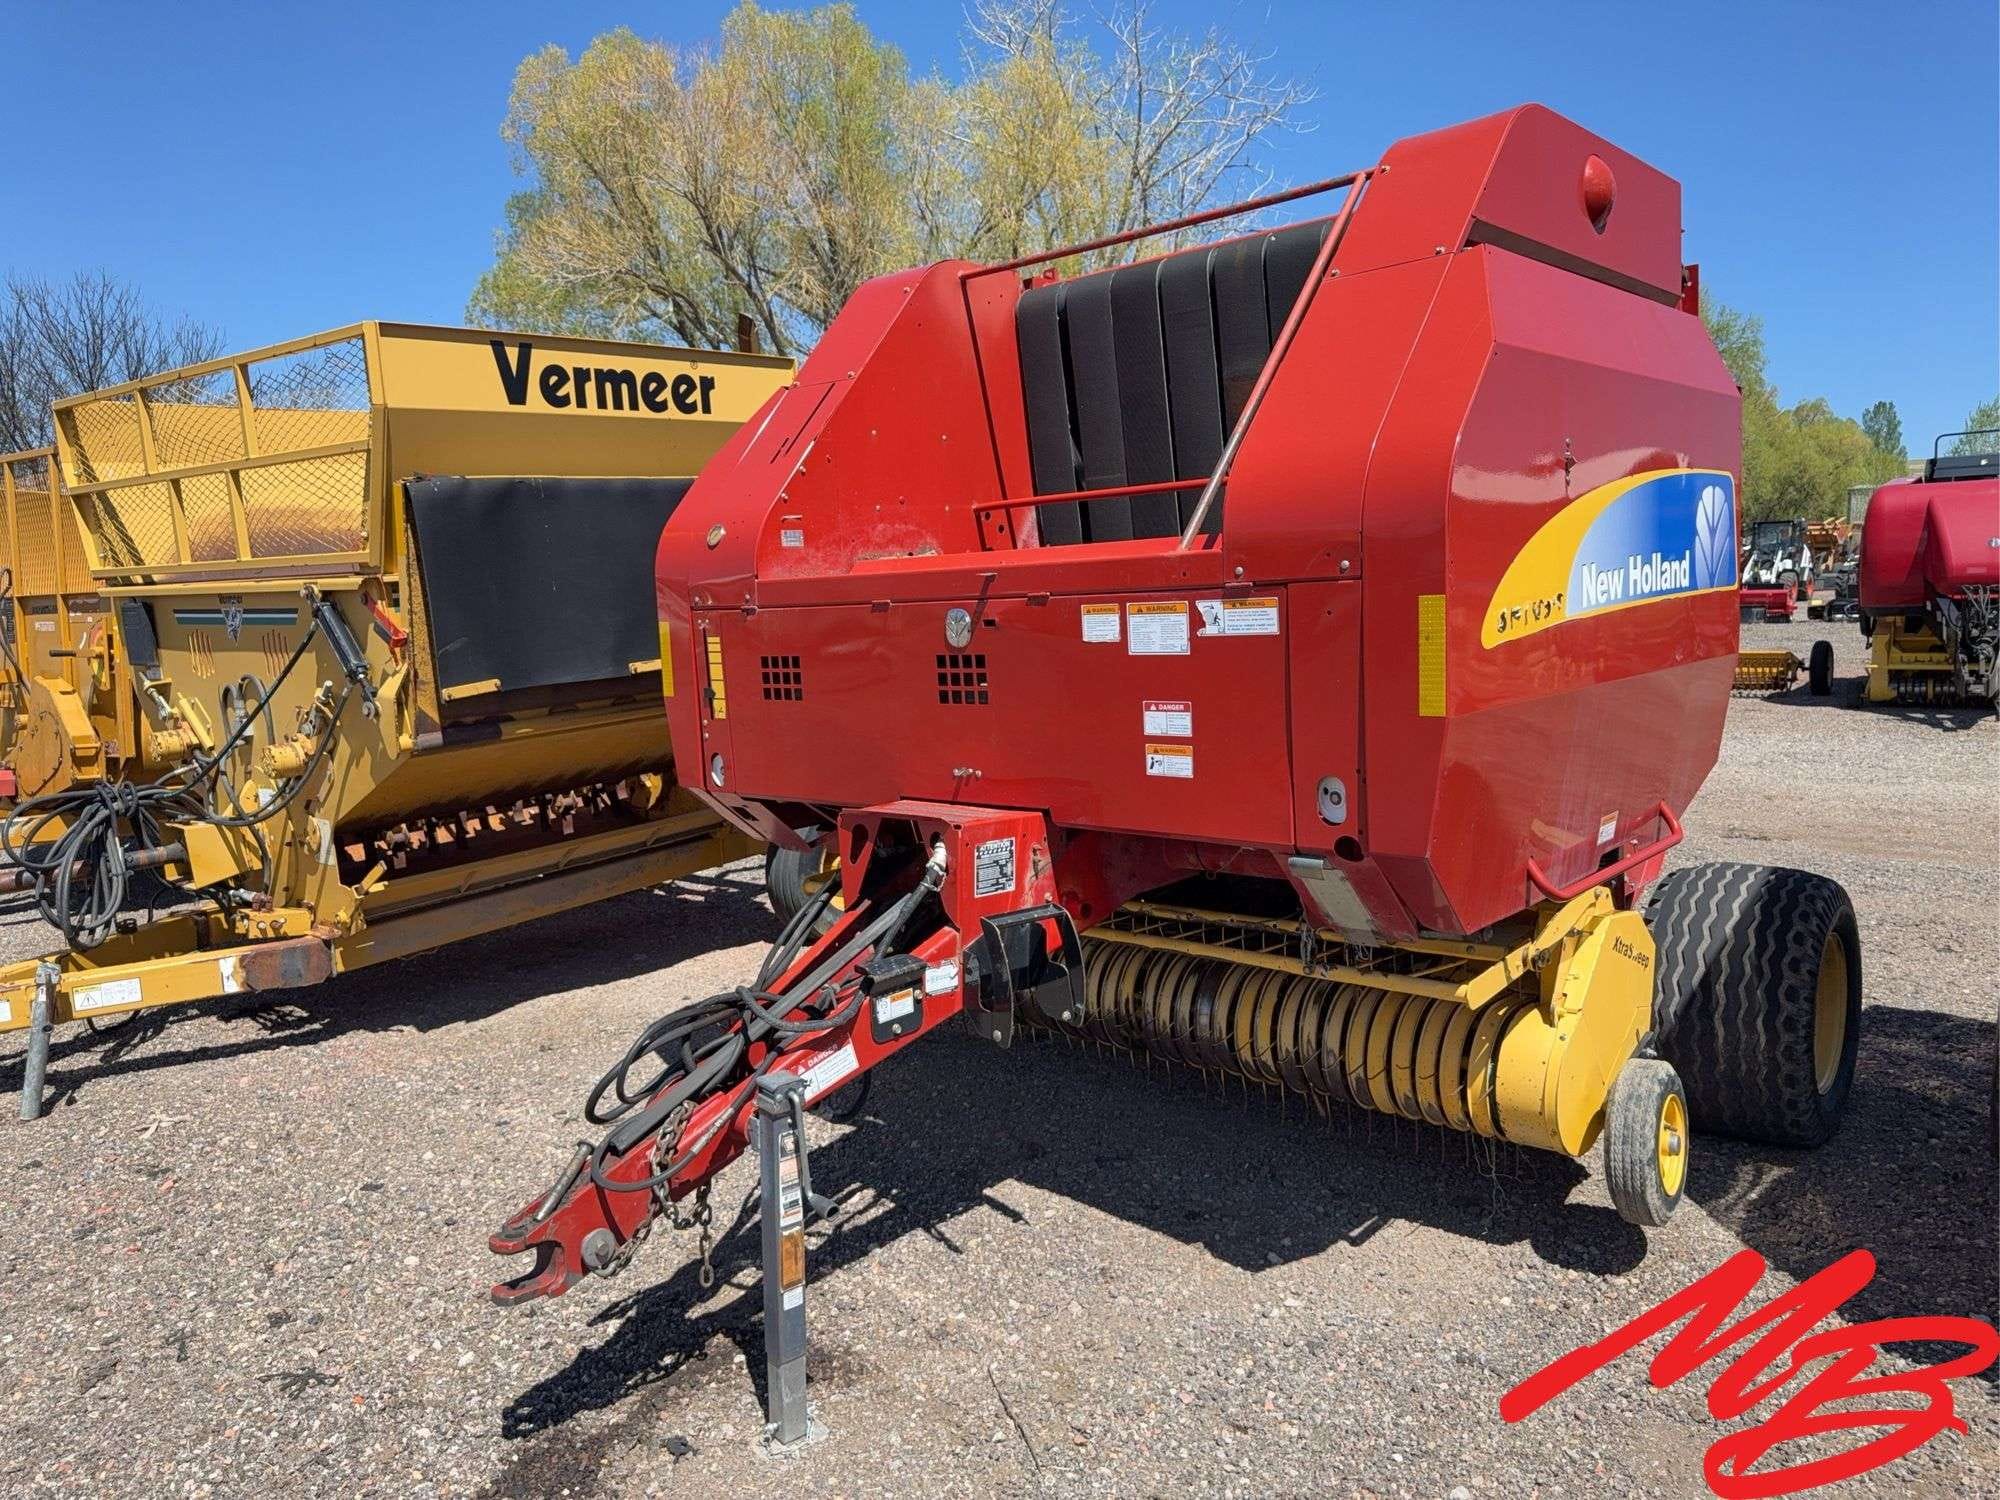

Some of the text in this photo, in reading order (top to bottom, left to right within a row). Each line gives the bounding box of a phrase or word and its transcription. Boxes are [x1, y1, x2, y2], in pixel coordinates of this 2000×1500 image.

[490, 340, 715, 414] Vermeer
[1582, 550, 1690, 608] New Holland
[807, 1044, 838, 1067] DANGER
